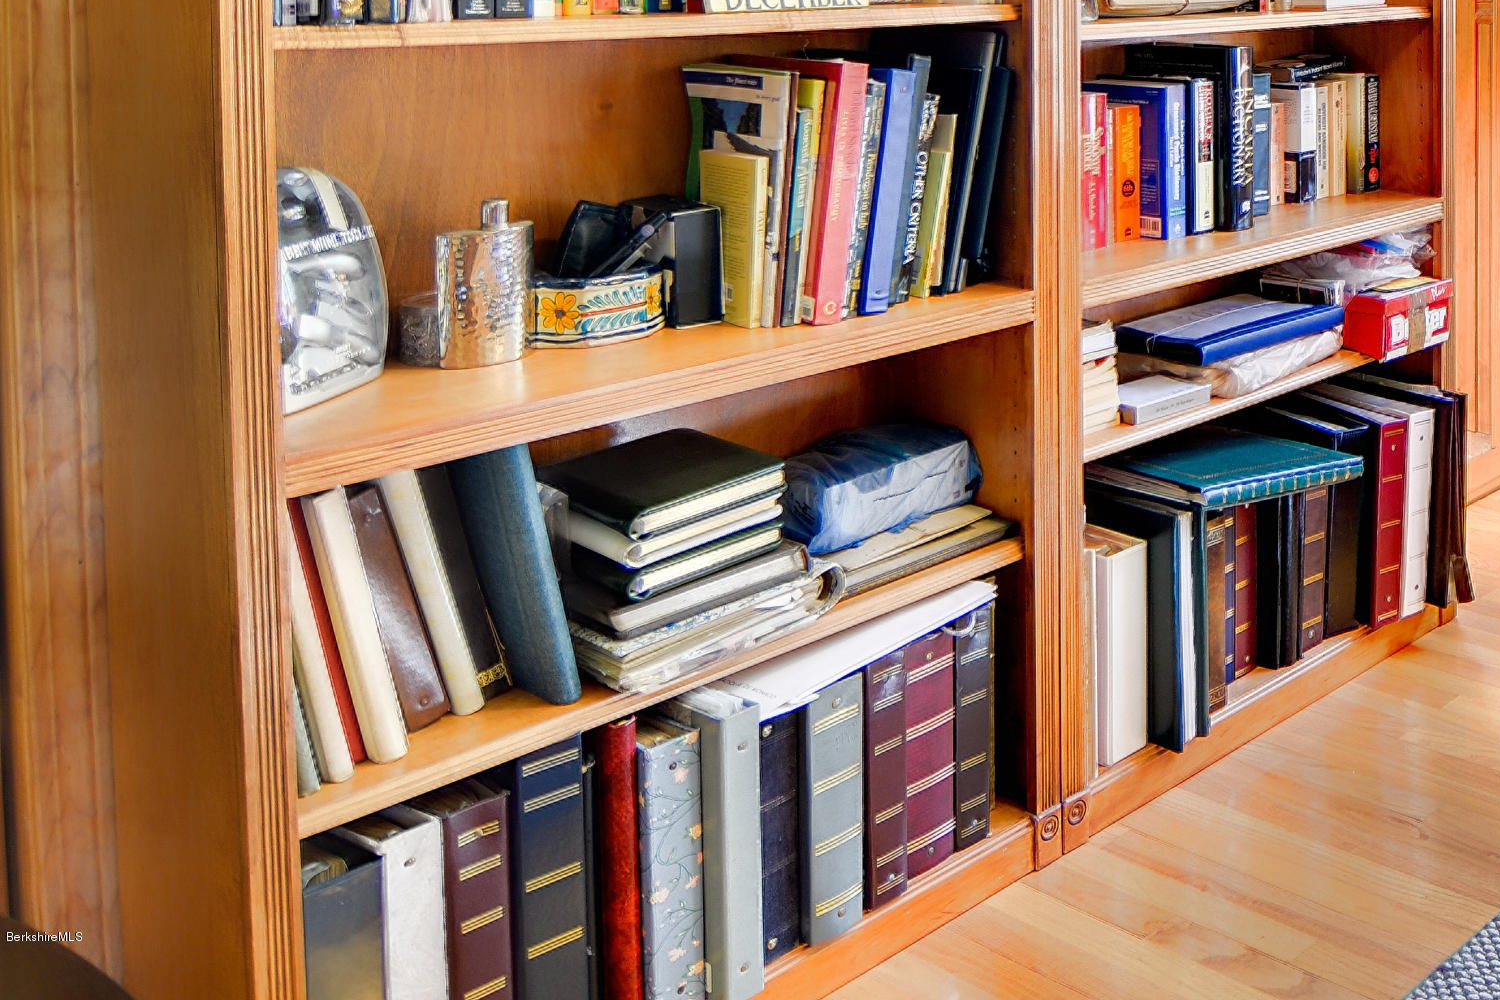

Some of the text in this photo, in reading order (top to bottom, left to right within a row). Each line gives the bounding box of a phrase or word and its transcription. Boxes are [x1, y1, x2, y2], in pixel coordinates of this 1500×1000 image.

[1232, 88, 1244, 188] DICTIONARY
[1244, 87, 1254, 186] ENCARTA
[831, 156, 844, 222] PHOTOGRAPHY
[903, 151, 928, 265] OTHER CRITERIA
